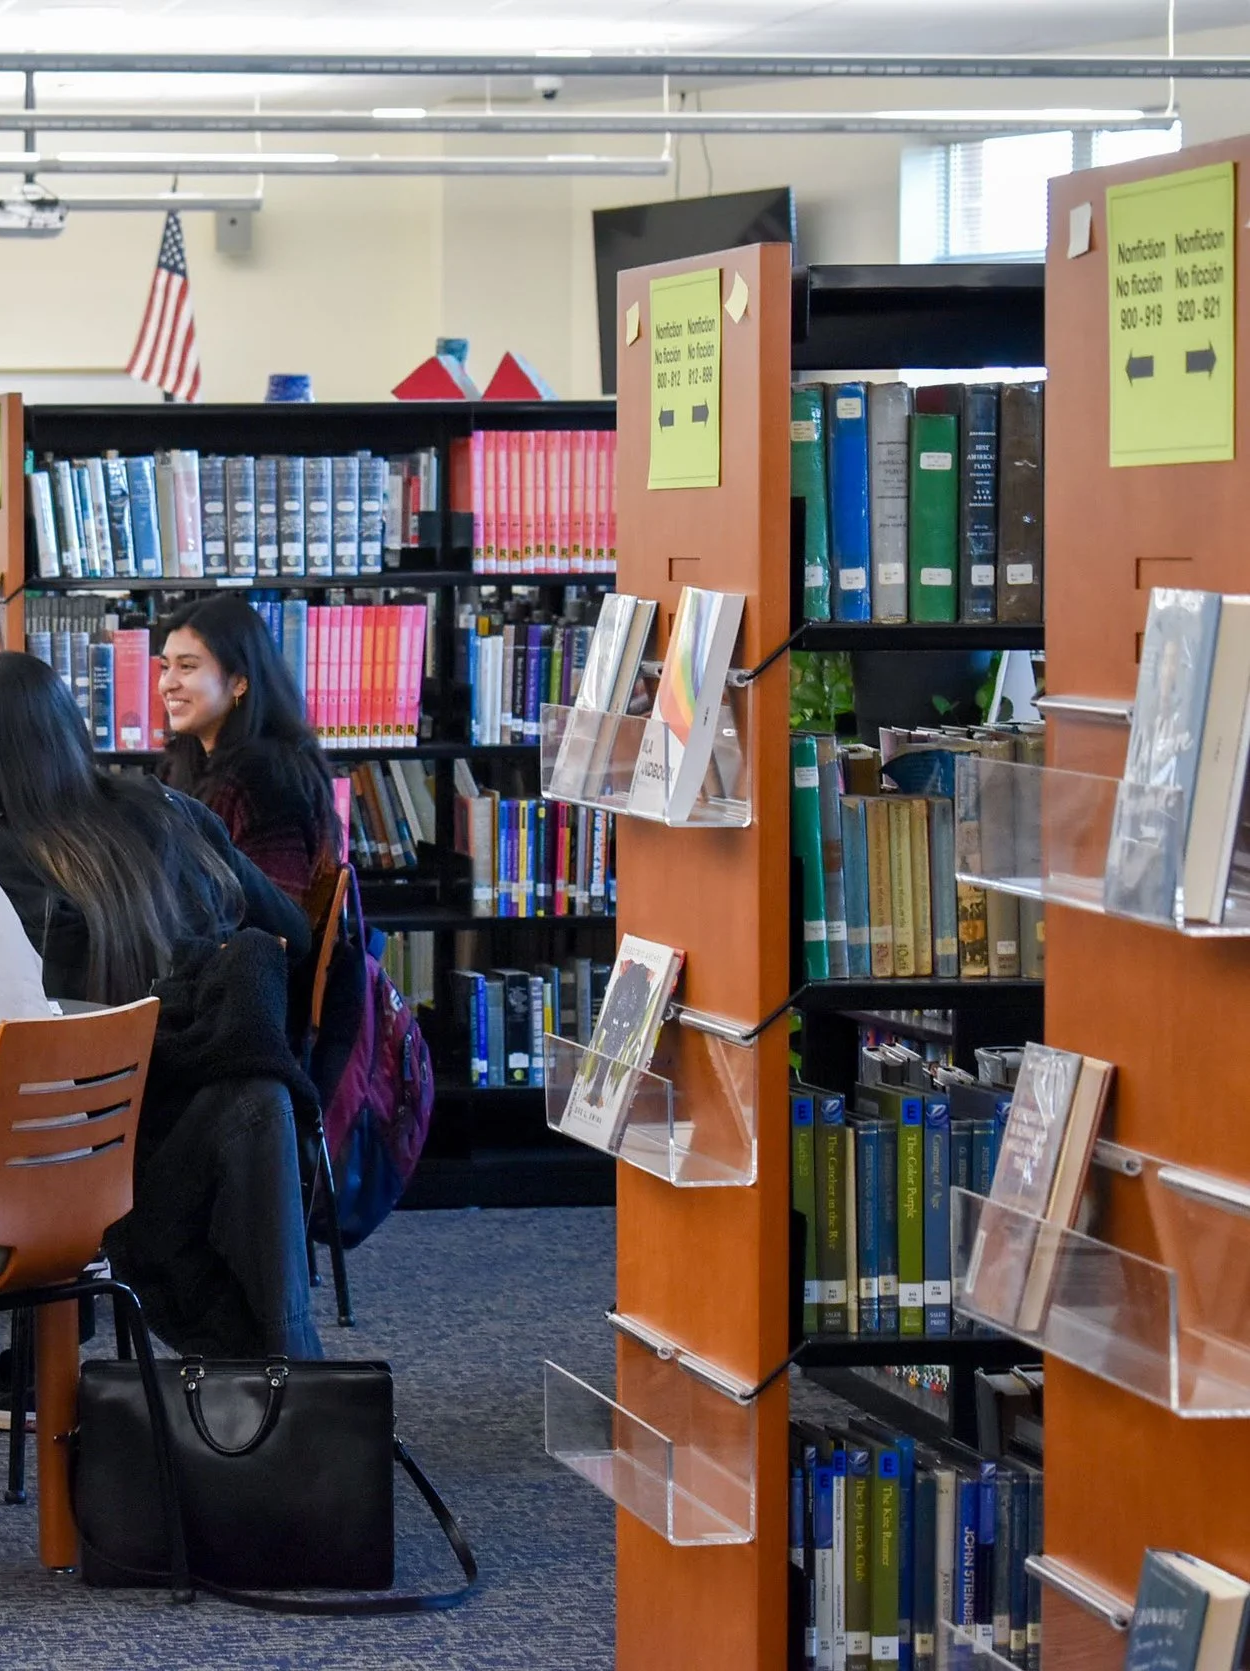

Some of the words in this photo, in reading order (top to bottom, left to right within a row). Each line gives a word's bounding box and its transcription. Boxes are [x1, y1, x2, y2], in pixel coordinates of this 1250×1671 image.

[1118, 238, 1166, 264] Nonfiction
[1174, 229, 1225, 255] Nonfiction
[1116, 276, 1130, 298] No
[1130, 272, 1163, 295] ficción
[1175, 268, 1189, 290] No
[1190, 262, 1224, 286] ficción
[1120, 307, 1138, 330] 900
[1145, 304, 1163, 328] 919
[1177, 299, 1196, 323] 920
[1203, 296, 1220, 320] 921
[656, 322, 682, 340] Nonfiction
[688, 316, 715, 334] Nonfiction
[654, 348, 662, 365] No
[664, 347, 681, 363] ficción
[688, 344, 696, 360] No
[696, 342, 714, 358] ficción
[657, 373, 667, 389] 800
[671, 370, 681, 387] 812
[688, 369, 698, 385] 812
[318, 727, 324, 736] R
[328, 727, 335, 735] R
[340, 727, 347, 735] R
[350, 726, 357, 735] R
[360, 725, 367, 734] R
[373, 725, 380, 735] R
[384, 724, 391, 734] R
[396, 724, 402, 734] R
[407, 724, 415, 734] R
[828, 1134, 837, 1154] The
[907, 1134, 917, 1154] The
[930, 1134, 943, 1173] Coming
[828, 1157, 838, 1196] Catcher
[907, 1156, 918, 1184] Color
[932, 1175, 943, 1187] of
[828, 1199, 838, 1208] in
[904, 1187, 917, 1218] Purple
[930, 1191, 942, 1209] Age
[828, 1211, 838, 1227] the
[826, 1230, 838, 1249] Rye
[856, 1480, 866, 1500] The
[882, 1486, 893, 1505] The
[854, 1501, 866, 1521] Joy
[882, 1508, 892, 1528] Kite
[855, 1525, 865, 1551] Luck
[964, 1526, 974, 1566] JOHN
[882, 1532, 892, 1566] Runner
[855, 1556, 865, 1582] Club
[963, 1570, 975, 1625] STEINBE
